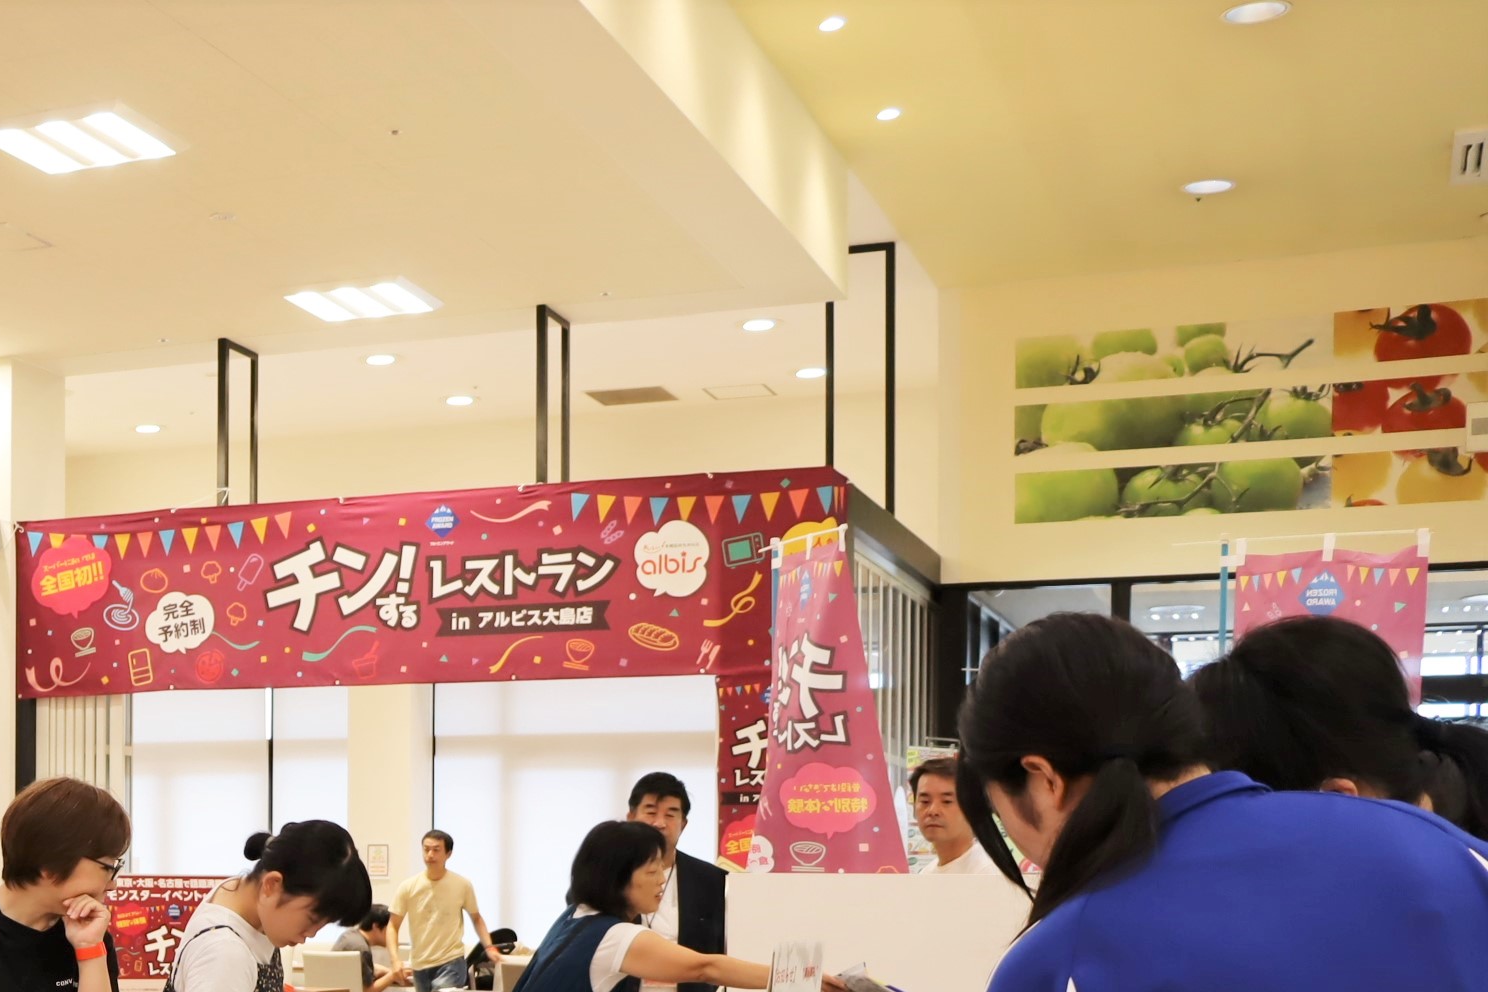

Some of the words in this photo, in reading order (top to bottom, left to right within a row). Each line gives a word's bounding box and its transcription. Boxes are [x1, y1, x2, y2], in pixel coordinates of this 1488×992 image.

[431, 551, 615, 598] レストラン
[641, 552, 702, 575] albis
[40, 561, 104, 596] 全国初!!
[163, 600, 195, 622] 完全
[451, 612, 469, 630] in
[477, 606, 593, 629] アルビス大島店
[157, 618, 206, 643] 予約制
